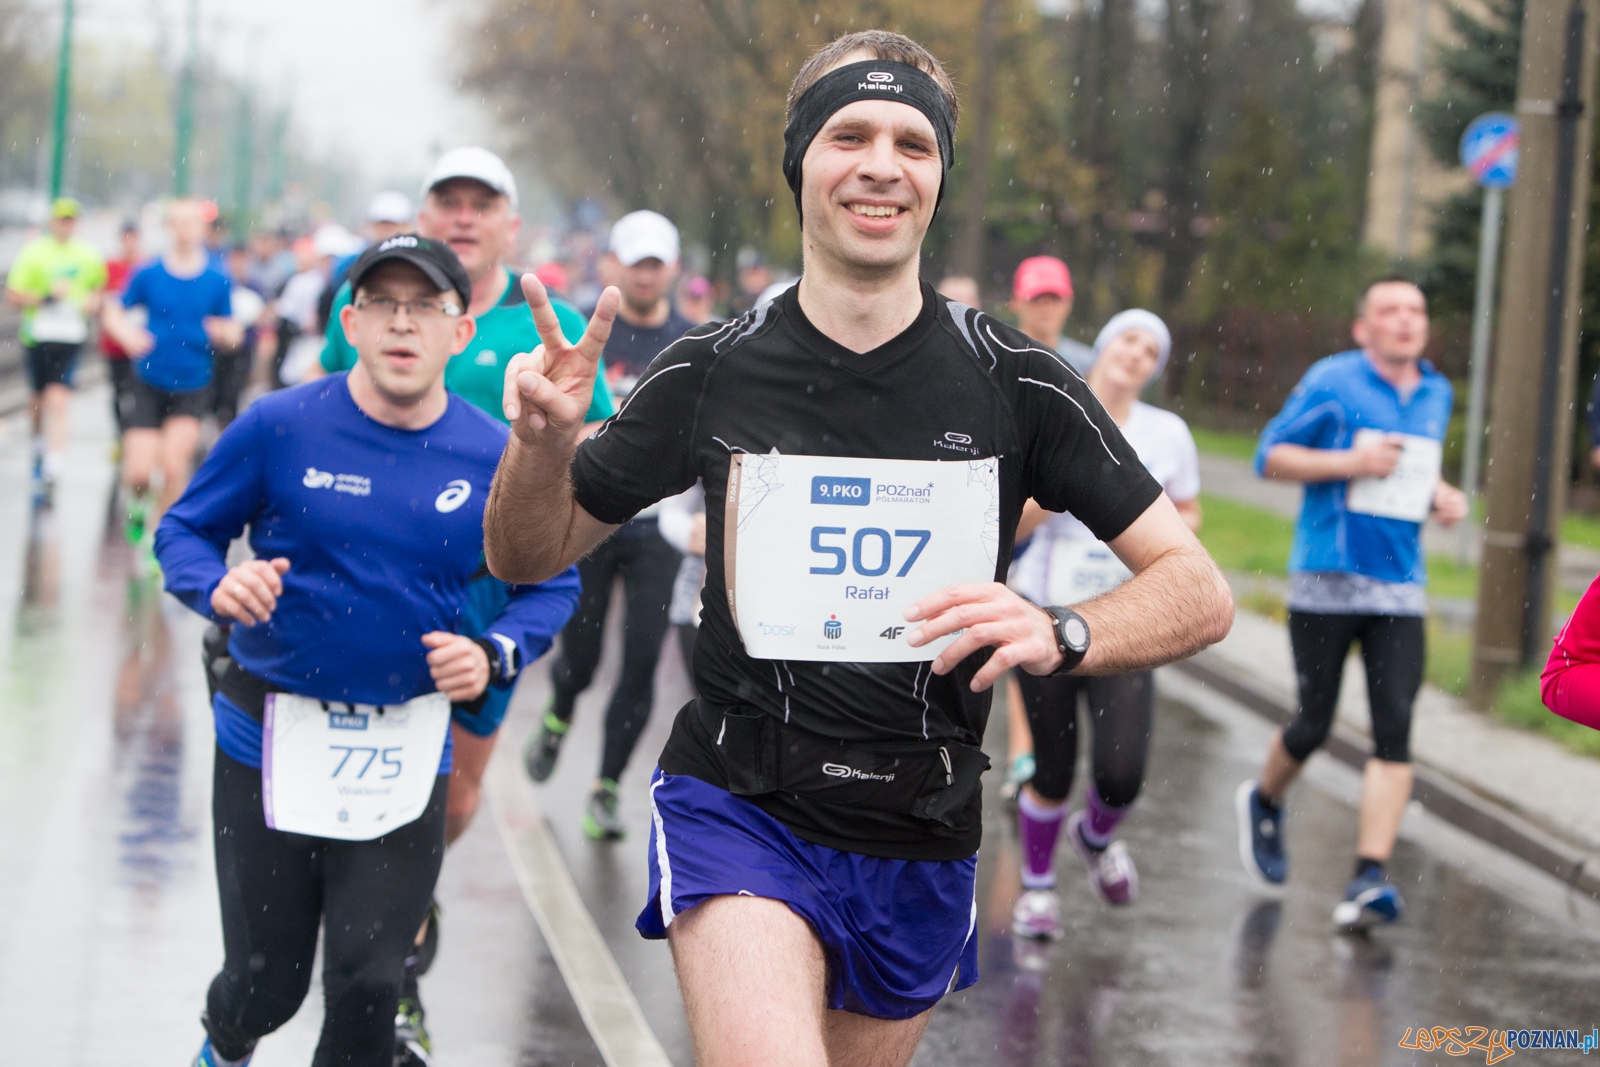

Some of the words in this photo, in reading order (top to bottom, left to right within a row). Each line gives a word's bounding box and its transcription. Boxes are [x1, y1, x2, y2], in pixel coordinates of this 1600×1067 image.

[858, 82, 903, 93] Kalenji
[933, 440, 980, 455] Kalenji
[809, 526, 932, 578] 507
[845, 586, 891, 600] Rafał
[879, 626, 906, 640] 4F
[329, 745, 403, 780] 775
[851, 768, 896, 783] Kalenji
